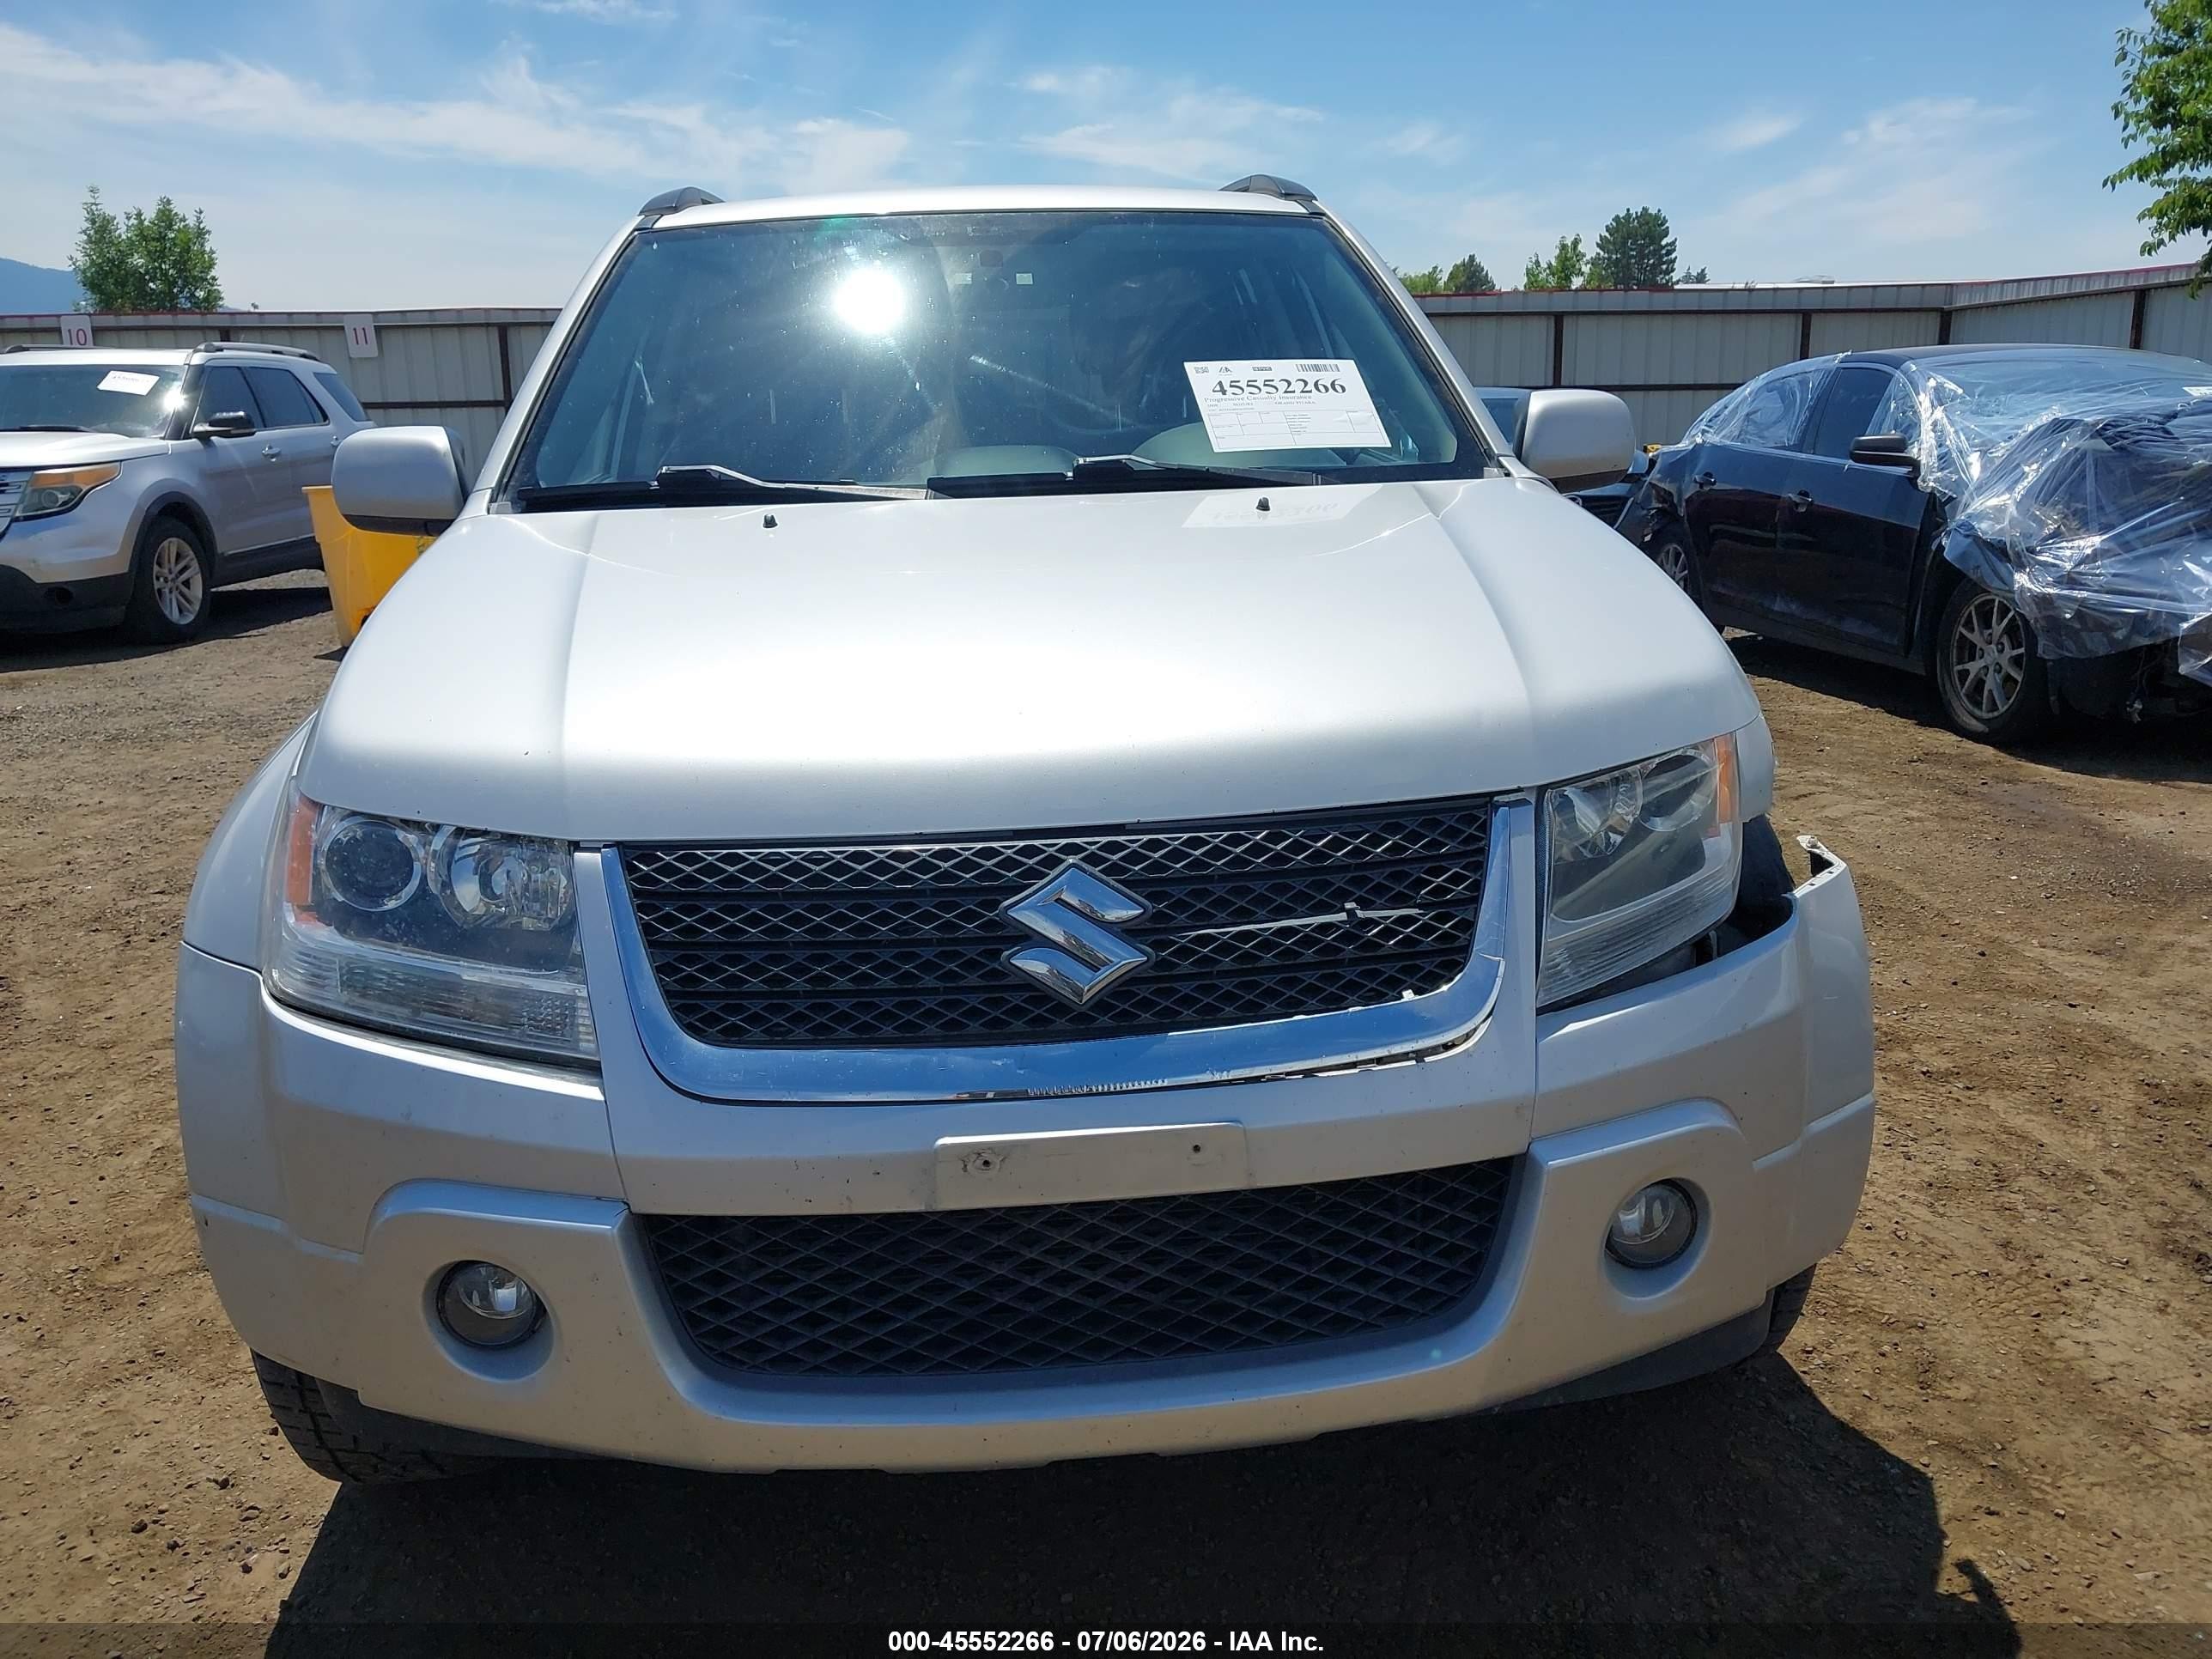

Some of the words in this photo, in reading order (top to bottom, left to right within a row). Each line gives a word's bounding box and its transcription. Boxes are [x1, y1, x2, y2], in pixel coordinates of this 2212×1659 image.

[68, 328, 87, 346] 10
[353, 327, 368, 345] 11
[1212, 378, 1346, 396] 45552266
